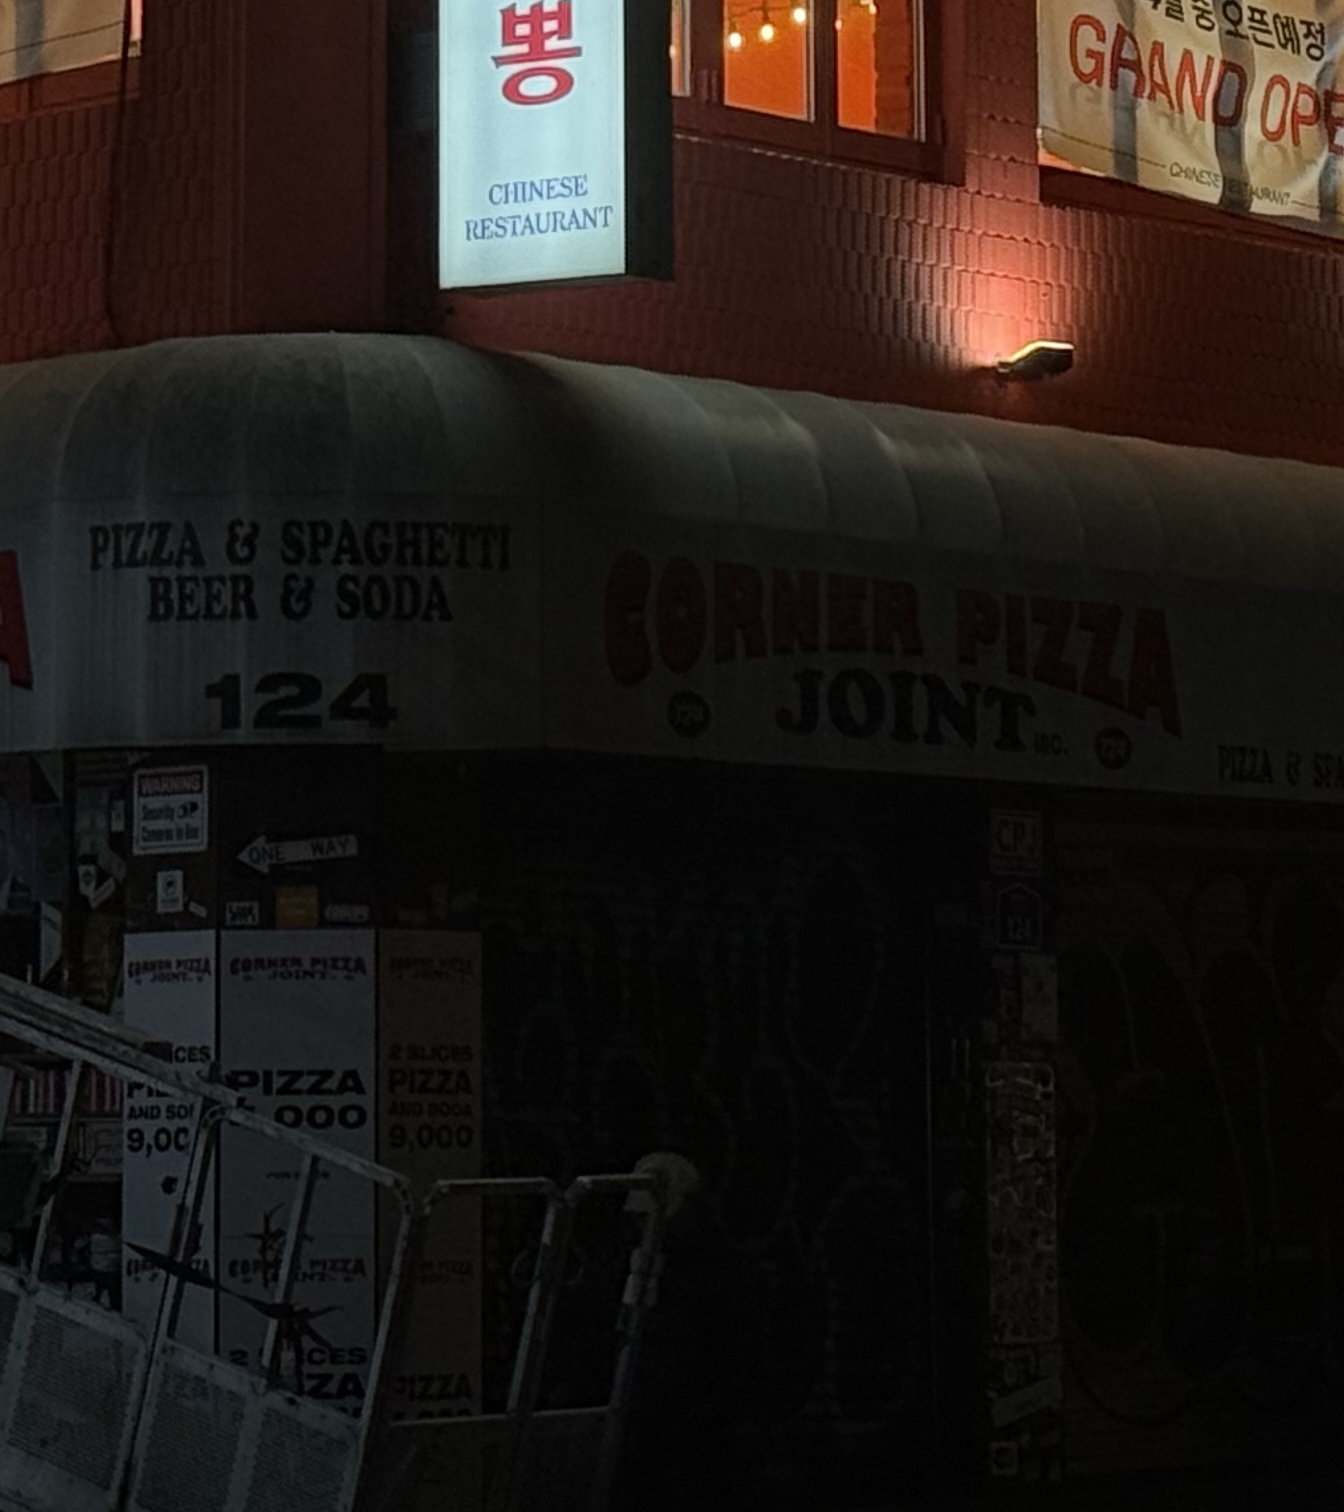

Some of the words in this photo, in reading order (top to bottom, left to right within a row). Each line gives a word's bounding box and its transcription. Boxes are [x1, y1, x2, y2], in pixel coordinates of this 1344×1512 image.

[1069, 13, 1248, 128] GRAND
[488, 175, 588, 205] CHINESE
[464, 205, 613, 242] RESTAURANT
[89, 519, 206, 571] PIZZA
[226, 518, 258, 566] &
[280, 518, 513, 571] SPAGHETTI
[147, 574, 257, 623] BEER
[280, 574, 314, 622] &
[336, 574, 454, 623] SODA
[604, 549, 924, 687] CORNER
[957, 587, 1183, 741] PIZZA
[204, 671, 399, 731] 124
[774, 668, 1038, 753] JOINT
[1217, 744, 1274, 784] PIZZA
[139, 773, 202, 796] WARNING
[248, 844, 286, 866] ONE
[310, 838, 351, 858] WAY
[128, 959, 173, 978] CORNER
[177, 957, 212, 976] PIZZA
[229, 956, 304, 976] CORNER
[309, 955, 367, 976] PIZZA
[224, 1068, 367, 1096] PIZZA
[388, 1068, 473, 1095] PIZZA
[127, 1104, 161, 1120] AND
[309, 1258, 367, 1277] PIZZA
[229, 1349, 249, 1367] 2
